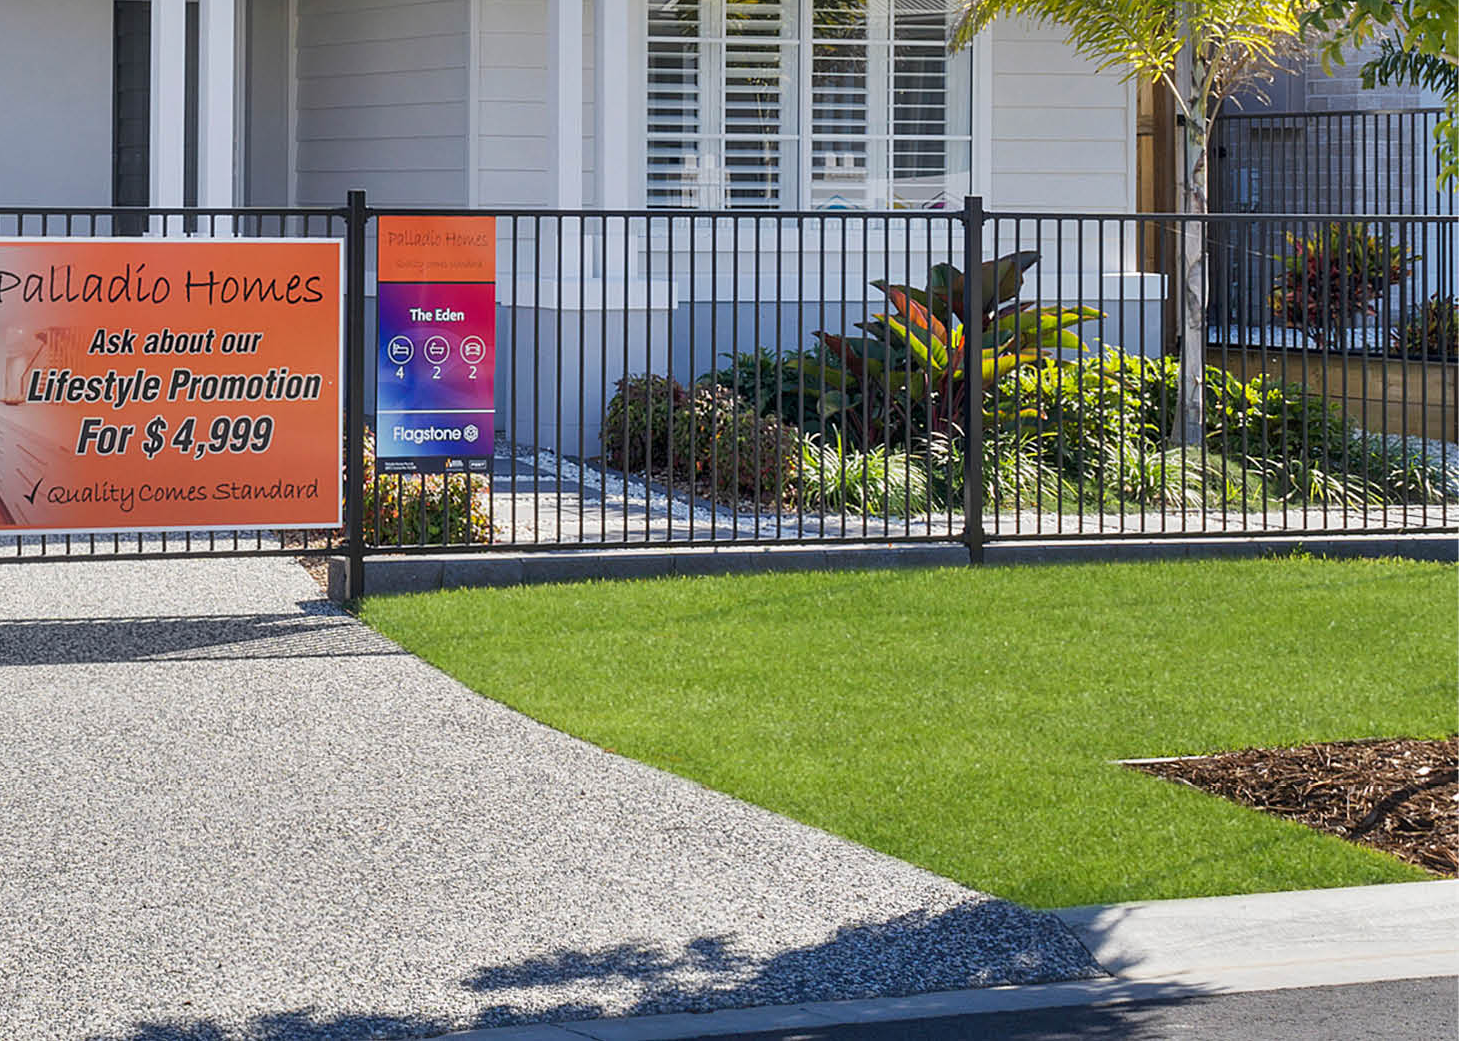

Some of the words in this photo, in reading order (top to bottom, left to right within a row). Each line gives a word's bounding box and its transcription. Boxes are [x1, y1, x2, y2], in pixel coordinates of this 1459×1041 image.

[445, 231, 488, 246] Homes
[185, 270, 324, 306] Homes
[409, 307, 433, 321] The
[435, 308, 465, 321] Eden
[88, 328, 136, 355] Ask
[144, 328, 215, 355] about
[221, 331, 263, 355] our
[395, 366, 404, 379] 4
[432, 366, 441, 379] 2
[468, 366, 477, 379] 2
[27, 369, 160, 409] Lifestyle
[168, 368, 322, 402] Promotion
[75, 417, 134, 455] For
[393, 426, 462, 444] Flagstone
[47, 480, 135, 512] Quality
[138, 483, 208, 502] Comes
[212, 479, 319, 501] Standard
